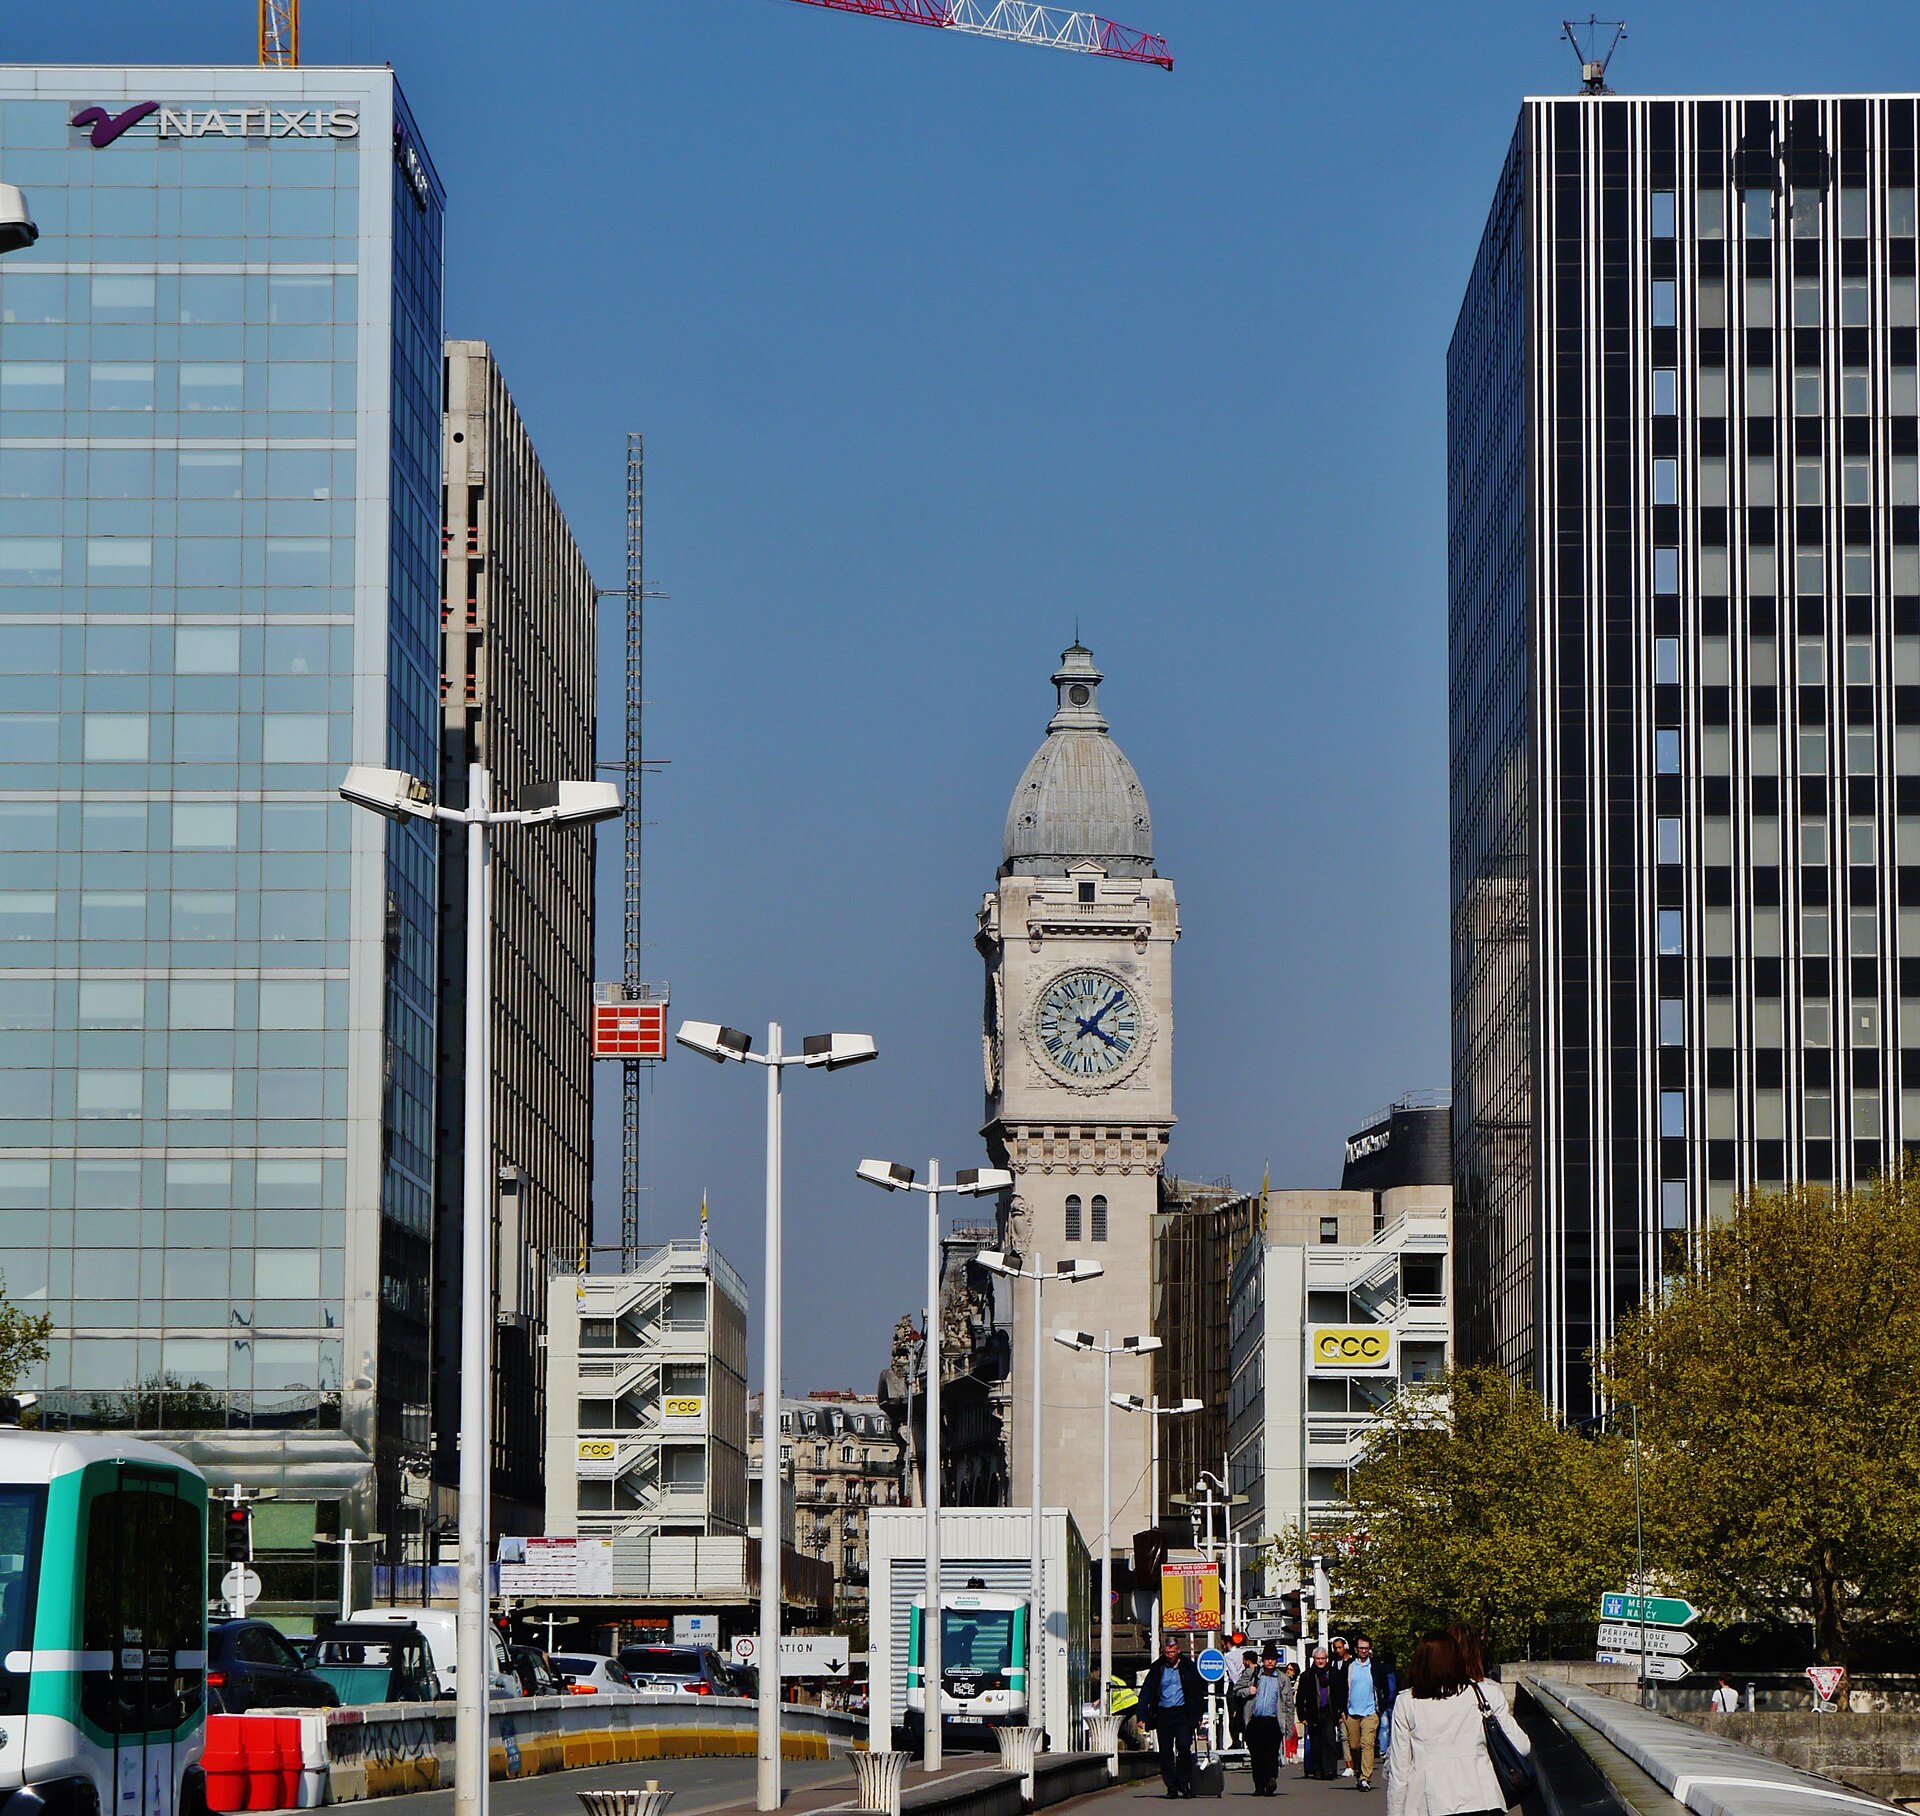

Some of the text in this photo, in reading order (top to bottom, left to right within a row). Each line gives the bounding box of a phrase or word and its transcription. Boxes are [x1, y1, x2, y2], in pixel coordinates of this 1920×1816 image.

[160, 108, 359, 138] NATIXIS
[1320, 1336, 1380, 1358] GCC
[668, 1401, 697, 1412] GCC
[581, 1444, 611, 1455] GCC
[1626, 1608, 1657, 1620] NACY
[1602, 1628, 1666, 1641] PÉRIPHÉIQUE
[1601, 1636, 1628, 1645] PORTE
[1644, 1641, 1669, 1649] ERCY
